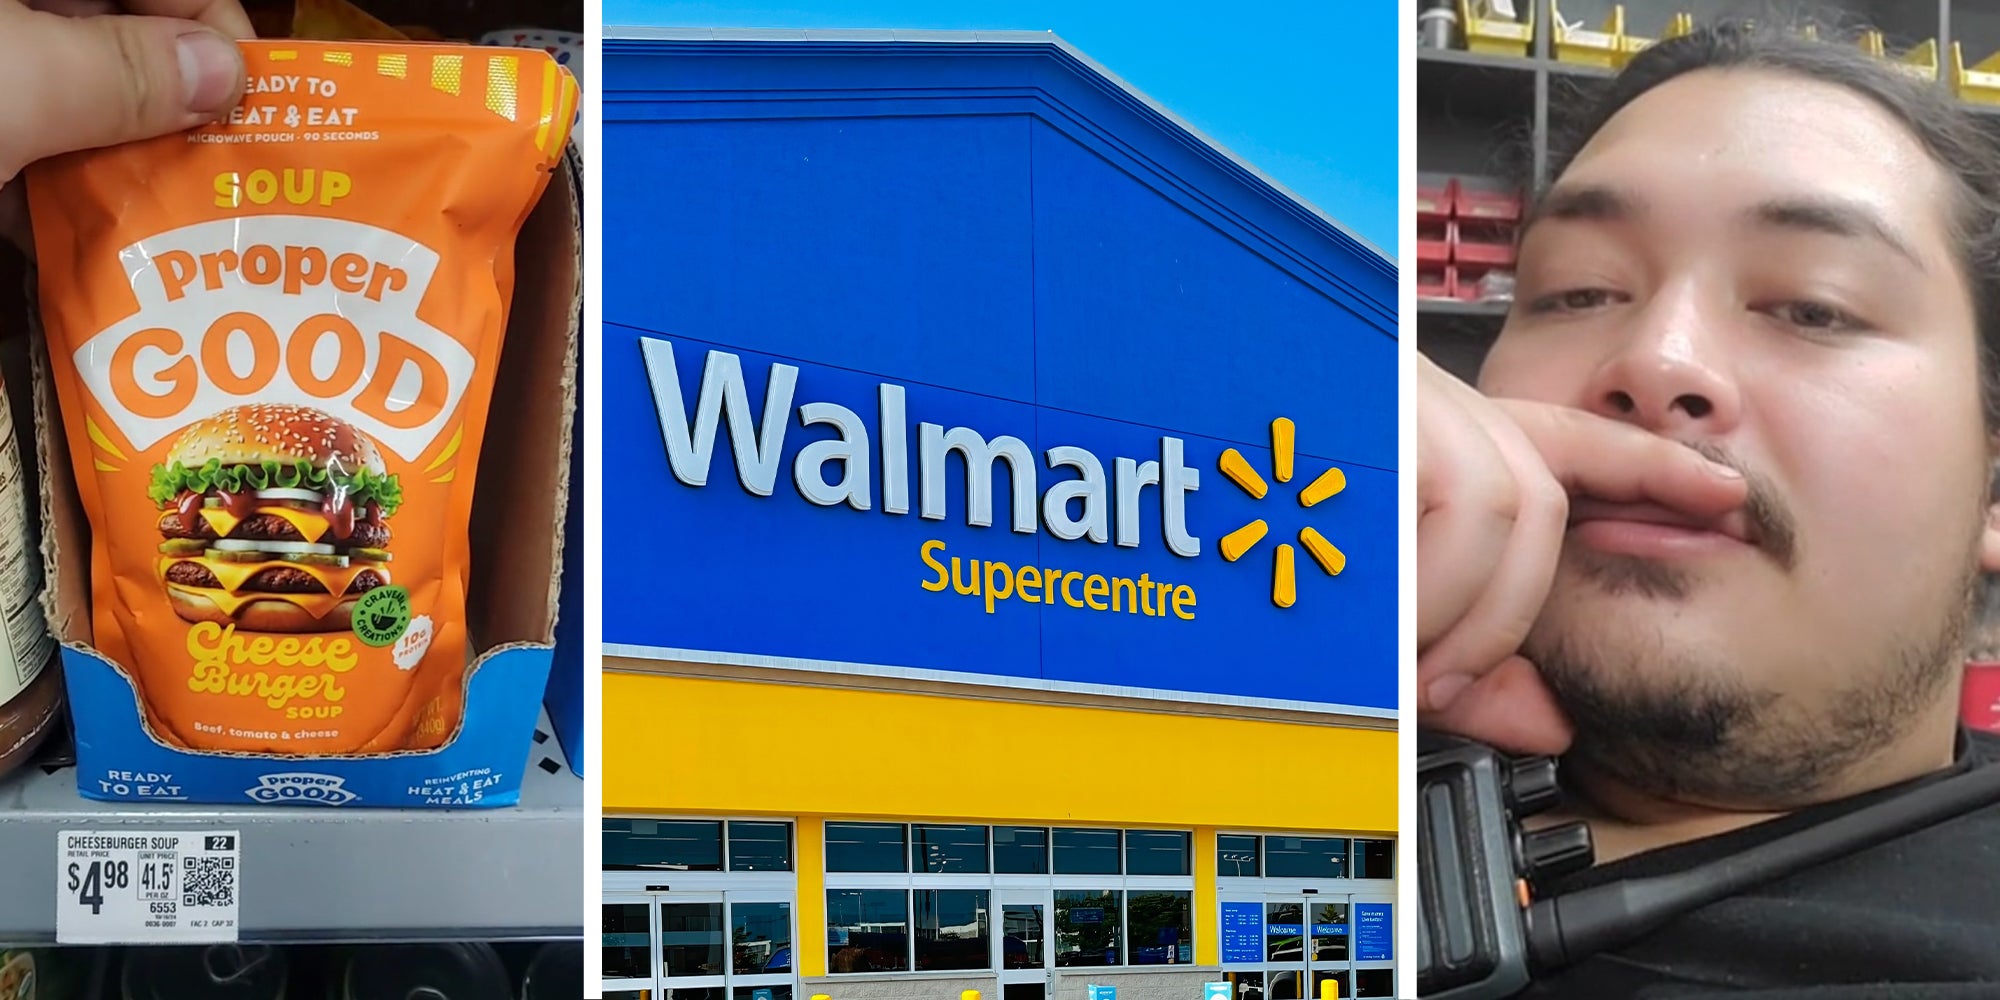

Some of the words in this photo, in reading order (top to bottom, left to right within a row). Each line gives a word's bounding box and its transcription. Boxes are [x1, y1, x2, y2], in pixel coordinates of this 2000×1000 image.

[245, 75, 300, 94] EADY
[306, 77, 337, 98] TO
[283, 104, 302, 128] &
[306, 106, 359, 126] EAT
[187, 132, 252, 144] MICROWAVE
[255, 132, 294, 143] POUCH
[303, 132, 320, 141] 90
[323, 131, 379, 141] SECONDS
[213, 168, 352, 209] SOUP
[152, 243, 408, 302] Proper
[109, 311, 449, 429] GOOD
[641, 336, 1201, 558] Walmart
[920, 539, 1197, 620] Supercentre
[356, 619, 403, 641] CREATIONS
[186, 620, 359, 672] Cheese
[187, 661, 345, 709] Burger
[285, 705, 344, 719] SOUP
[194, 721, 226, 736] Beef,
[229, 727, 278, 740] tomato
[281, 730, 291, 740] &
[294, 729, 339, 740] cheese
[108, 770, 172, 783] READY
[408, 786, 455, 796] HEAT
[458, 782, 470, 796] &
[472, 773, 503, 790] EAT
[424, 767, 491, 786] REINVENTING
[98, 780, 129, 796] TO
[137, 785, 182, 796] EAT
[255, 786, 347, 803] GOOD
[425, 790, 483, 805] MEALS
[67, 836, 148, 850] CHEESEBURGER
[151, 836, 179, 850] SOUP
[211, 837, 228, 850] 22
[150, 902, 177, 914] 6553
[1269, 925, 1297, 935] Welcome
[1316, 925, 1343, 934] Welcome
